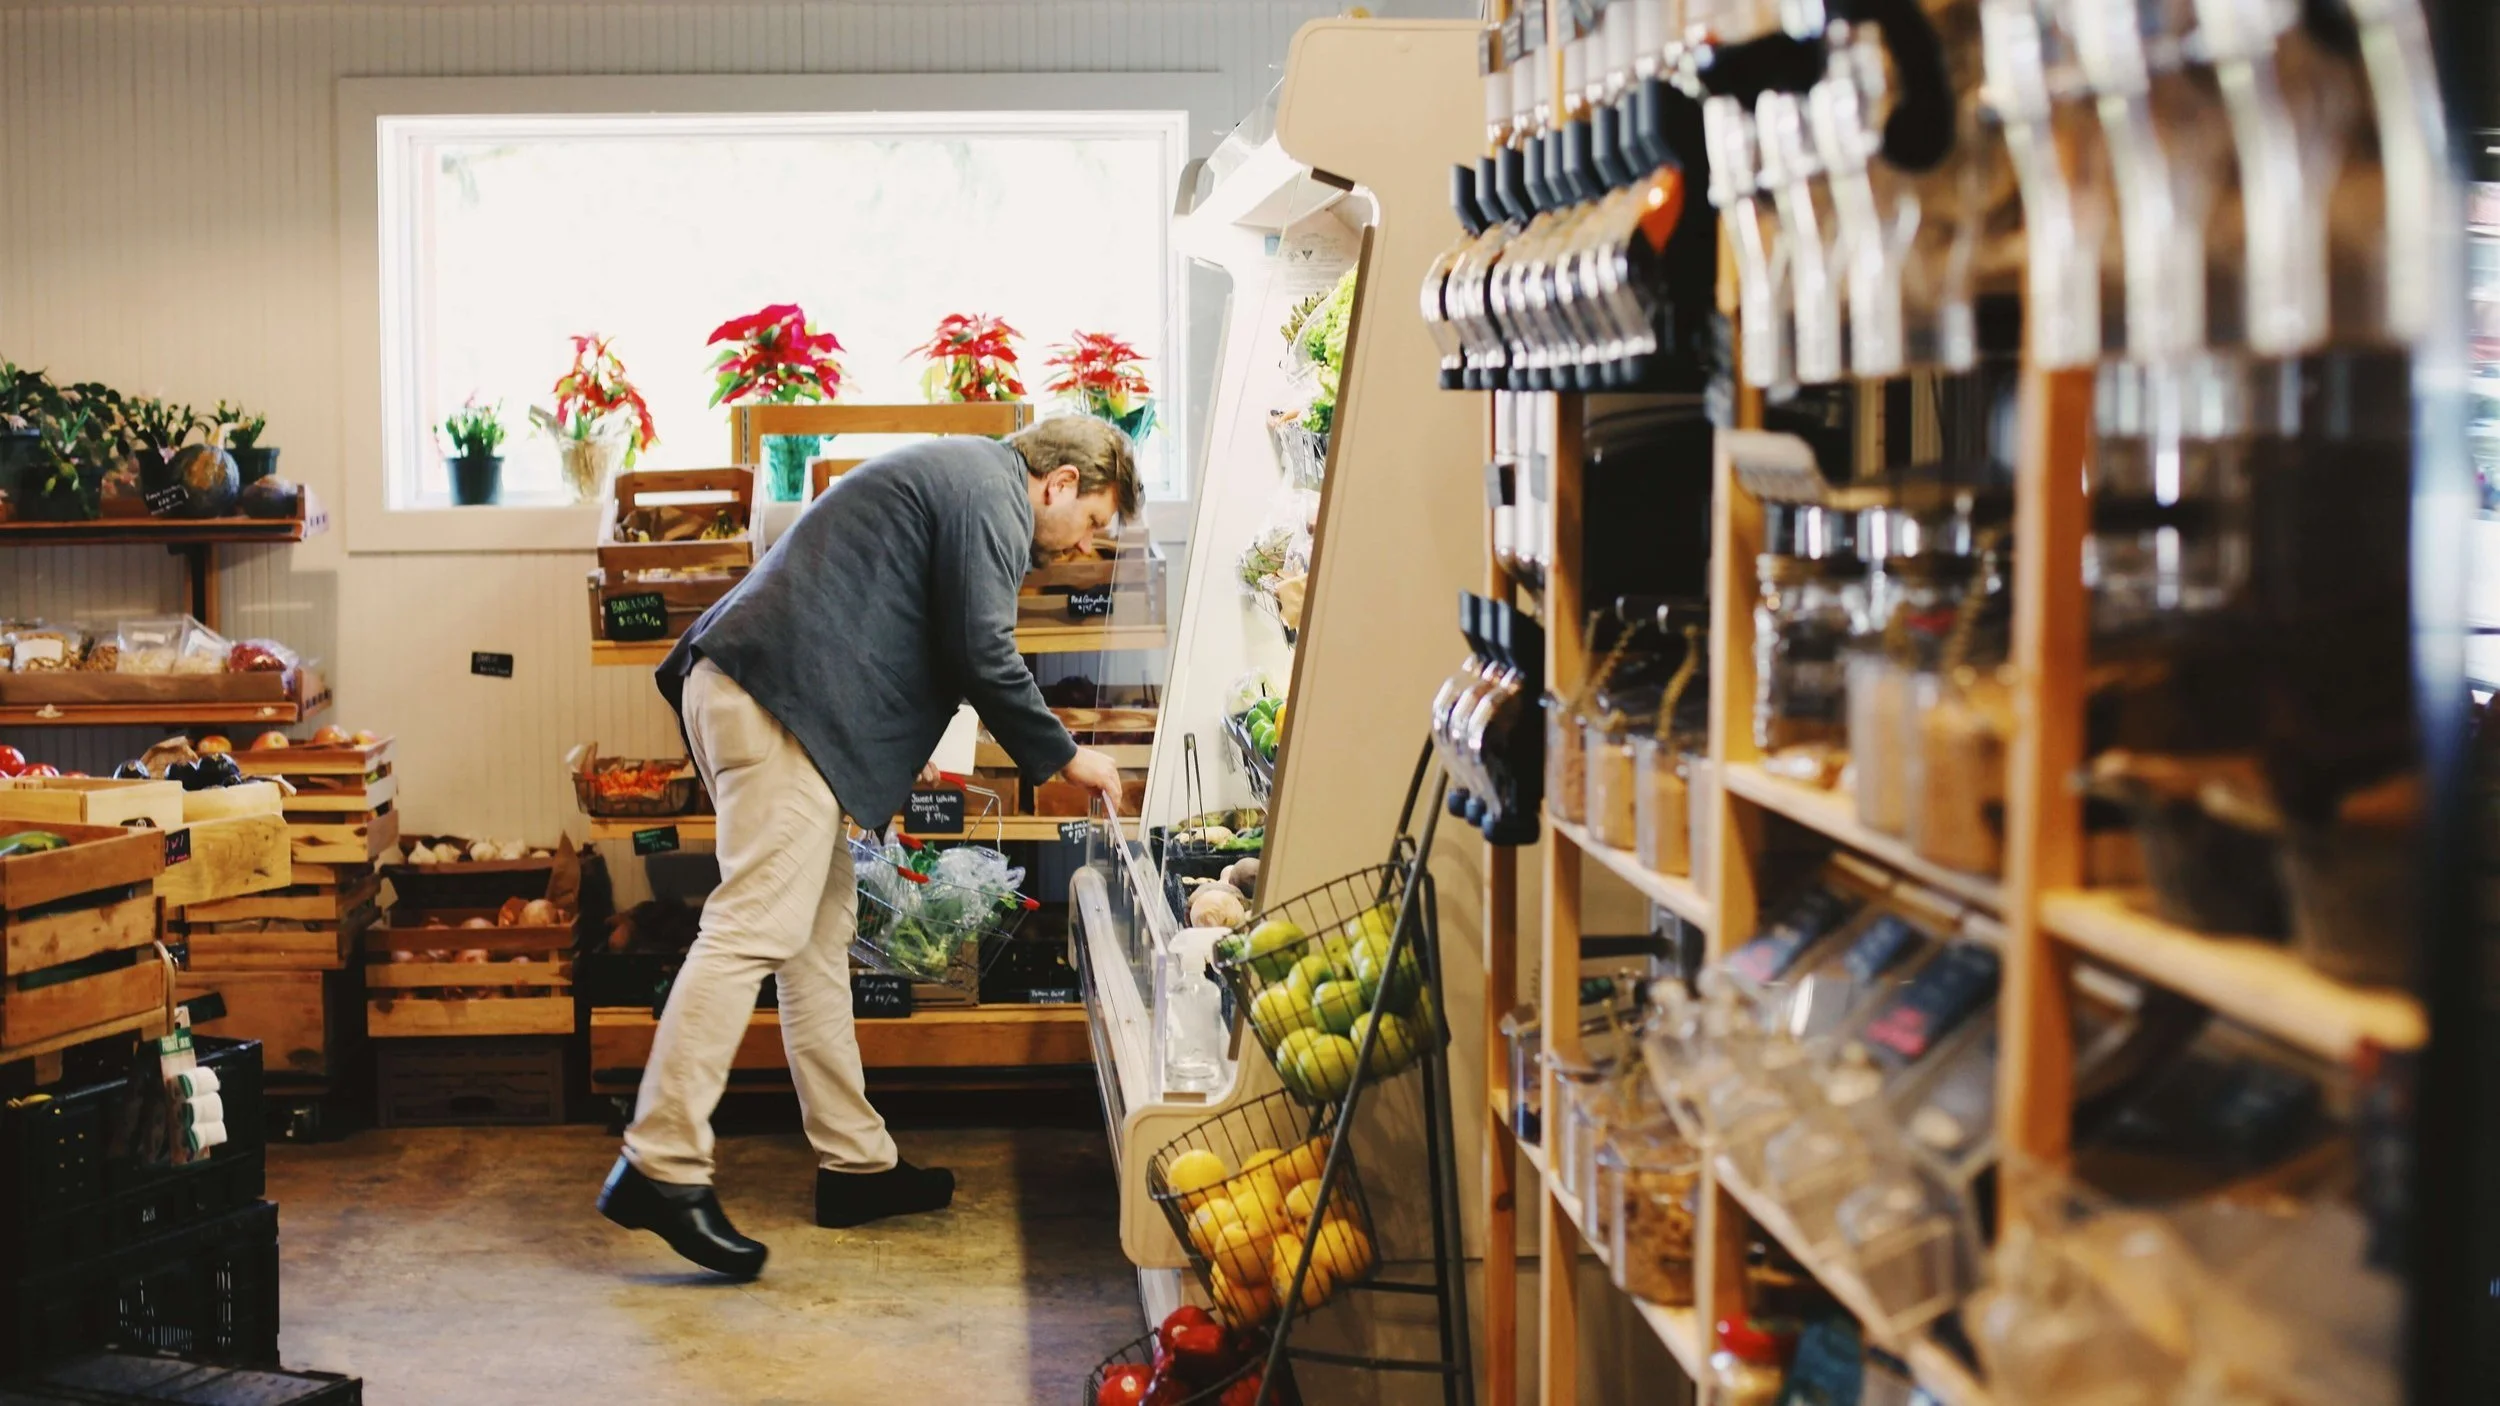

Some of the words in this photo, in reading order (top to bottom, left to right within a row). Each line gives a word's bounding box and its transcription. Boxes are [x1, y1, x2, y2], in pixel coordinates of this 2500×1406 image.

[611, 595, 658, 613] BANANAS
[911, 793, 933, 803] Sweet
[935, 795, 957, 803] White
